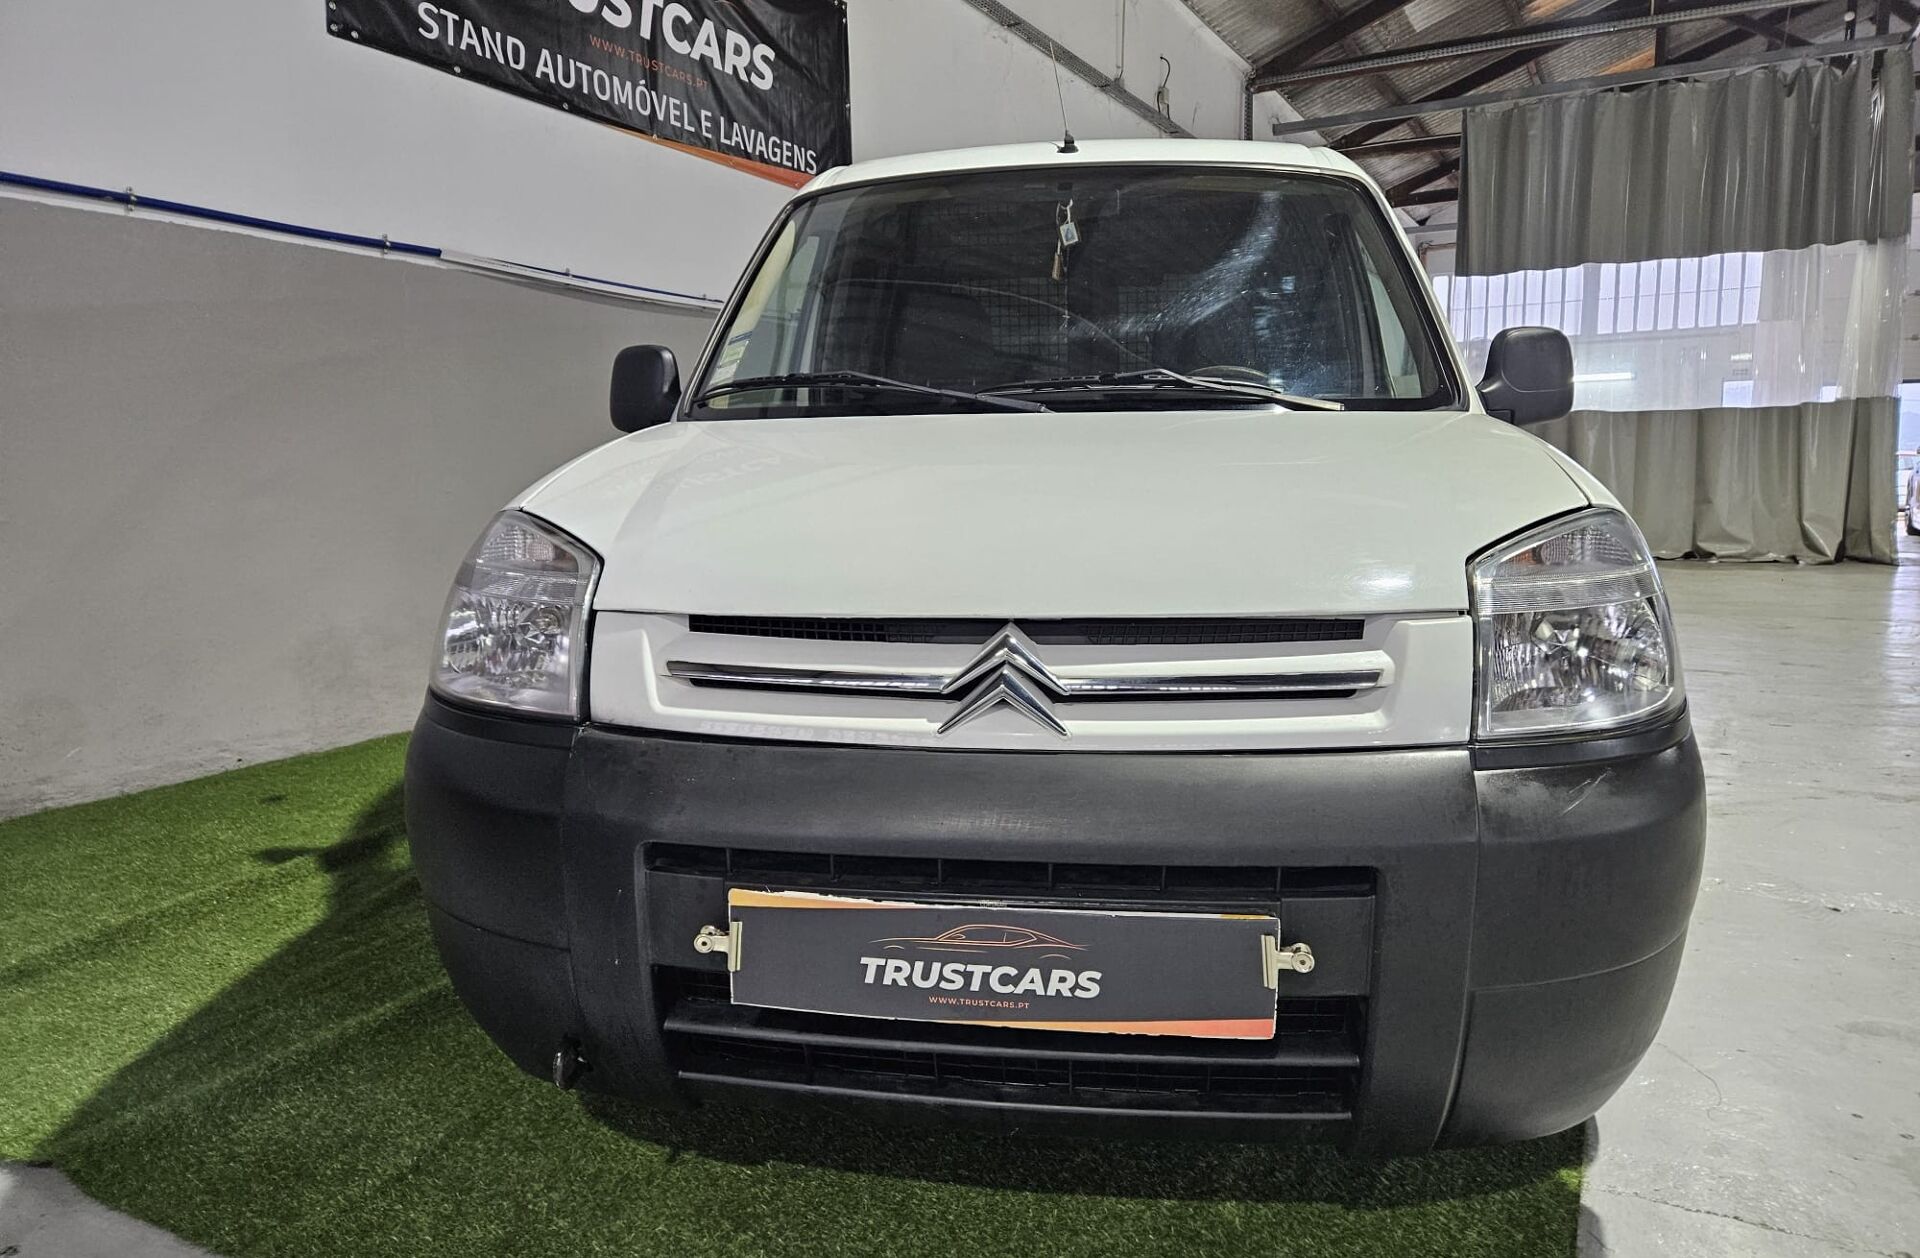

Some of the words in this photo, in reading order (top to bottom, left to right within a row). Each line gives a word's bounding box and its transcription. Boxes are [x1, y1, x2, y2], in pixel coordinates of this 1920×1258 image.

[568, 0, 776, 91] STCARS
[589, 34, 709, 90] WWW.TRUSTCARS.PT
[417, 1, 526, 71] STAND
[535, 47, 695, 133] AUTOMÓVEL
[700, 109, 713, 139] E
[719, 115, 817, 175] LAVAGENS
[860, 957, 1102, 999] TRUSTCARS
[928, 996, 1030, 1009] WWW.TRUSTCARS.PT
